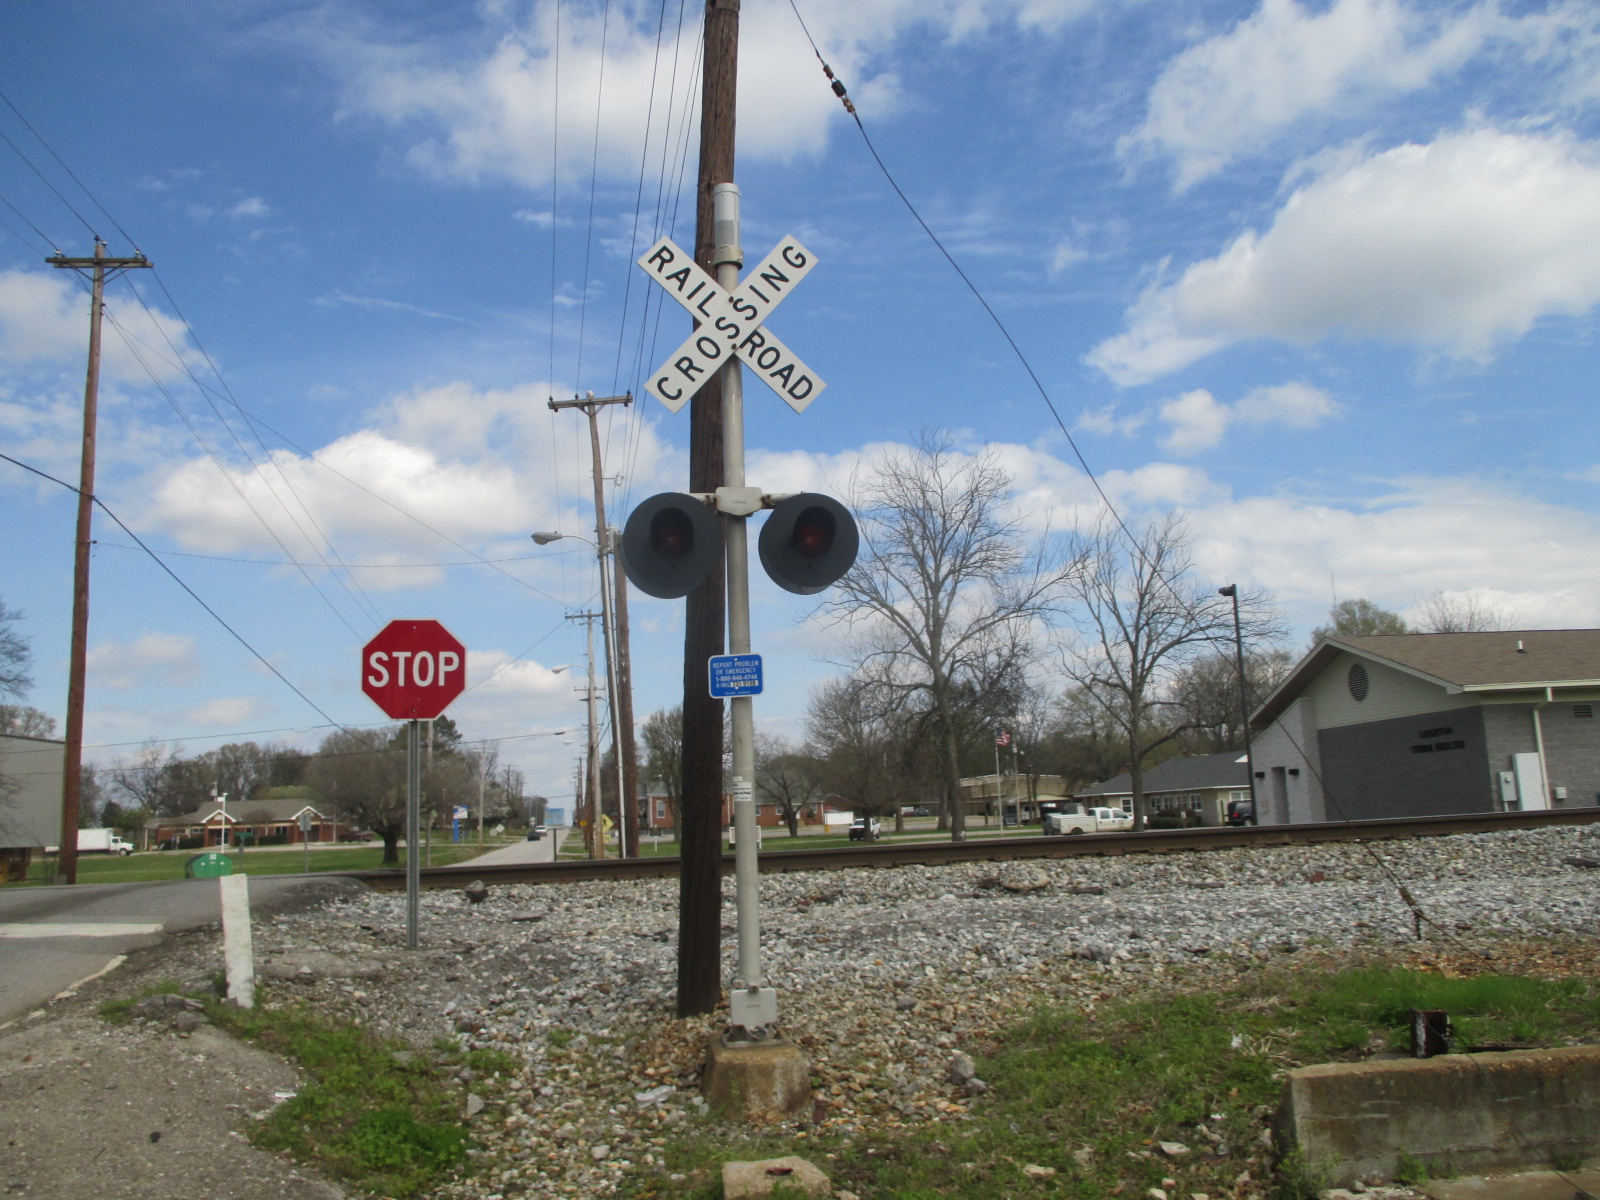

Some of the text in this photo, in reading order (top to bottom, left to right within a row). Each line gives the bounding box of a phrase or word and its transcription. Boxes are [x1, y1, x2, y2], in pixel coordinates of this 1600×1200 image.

[656, 245, 807, 401] CROSSING
[368, 650, 460, 688] STOP
[726, 667, 756, 675] EMERGENCY
